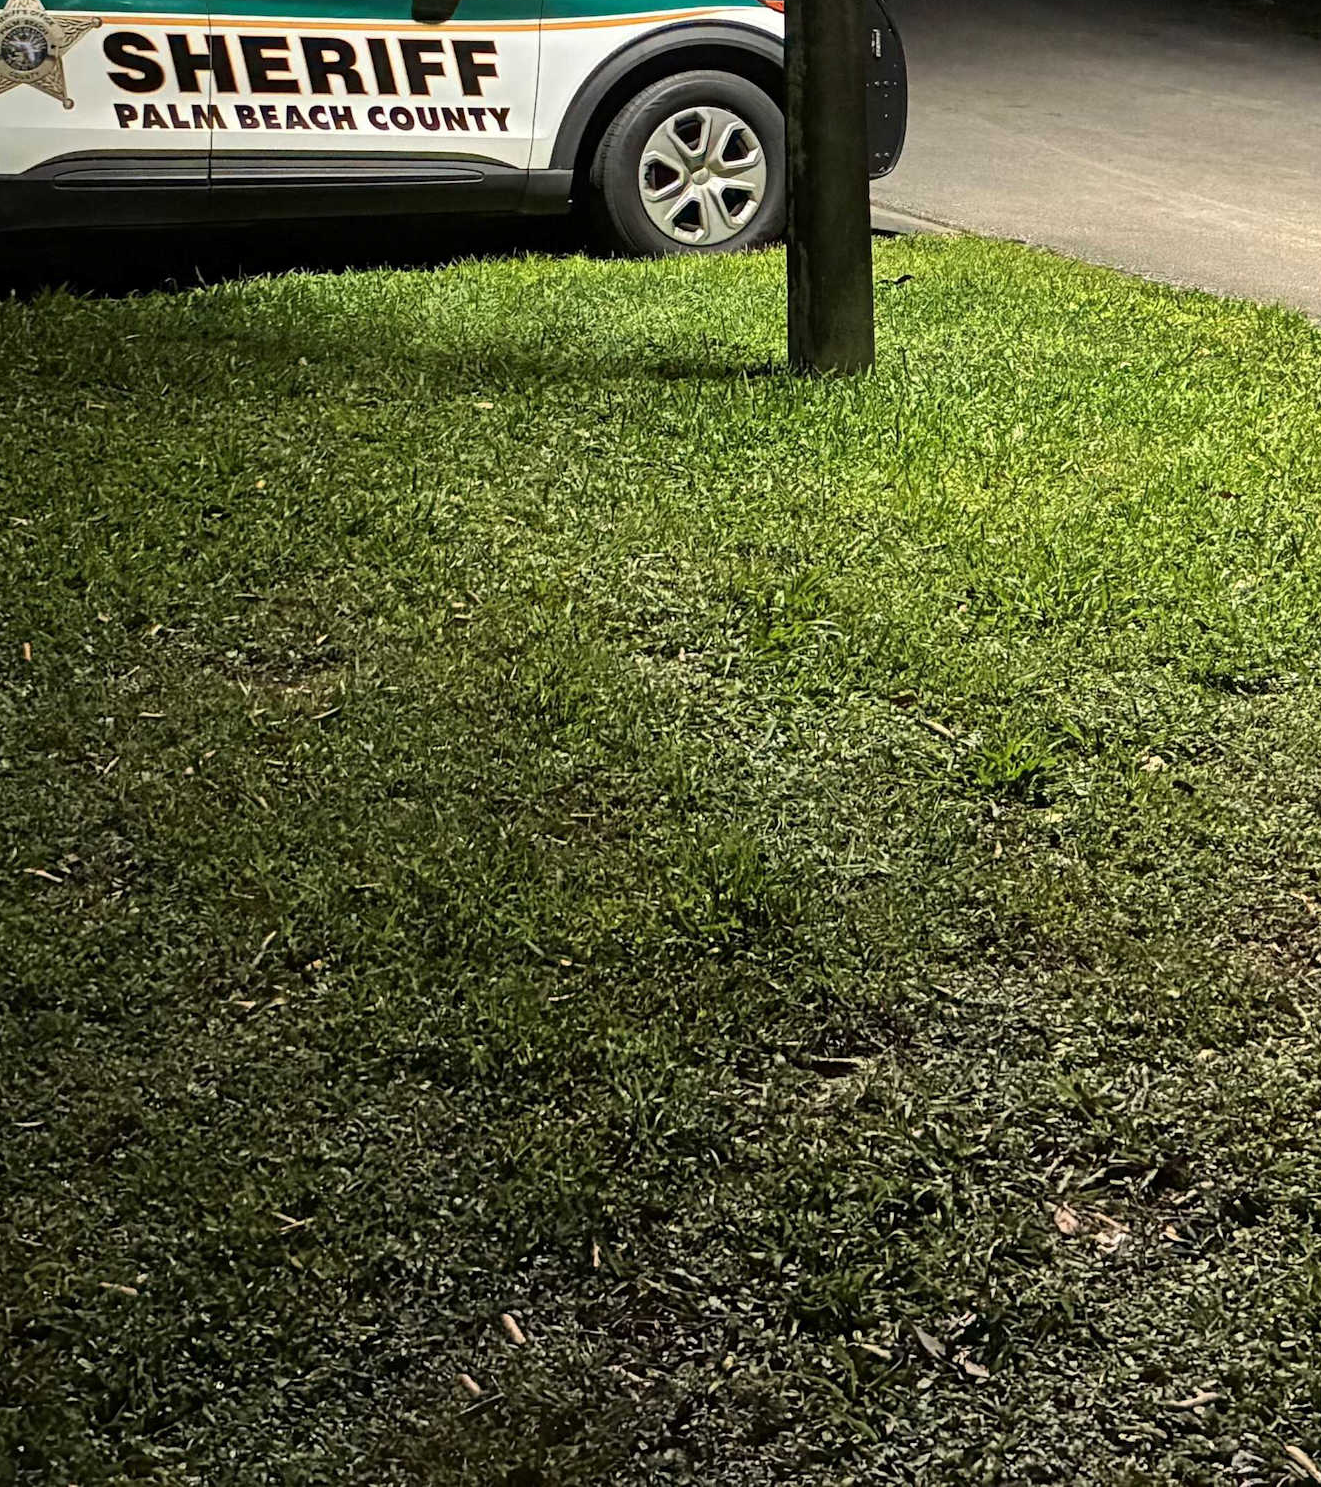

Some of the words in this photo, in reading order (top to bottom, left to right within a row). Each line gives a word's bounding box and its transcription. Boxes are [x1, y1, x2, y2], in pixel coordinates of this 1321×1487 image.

[102, 31, 500, 97] SHERIFF
[113, 103, 229, 130] PALM
[234, 104, 358, 131] BEACH
[367, 105, 511, 133] COUNTY
